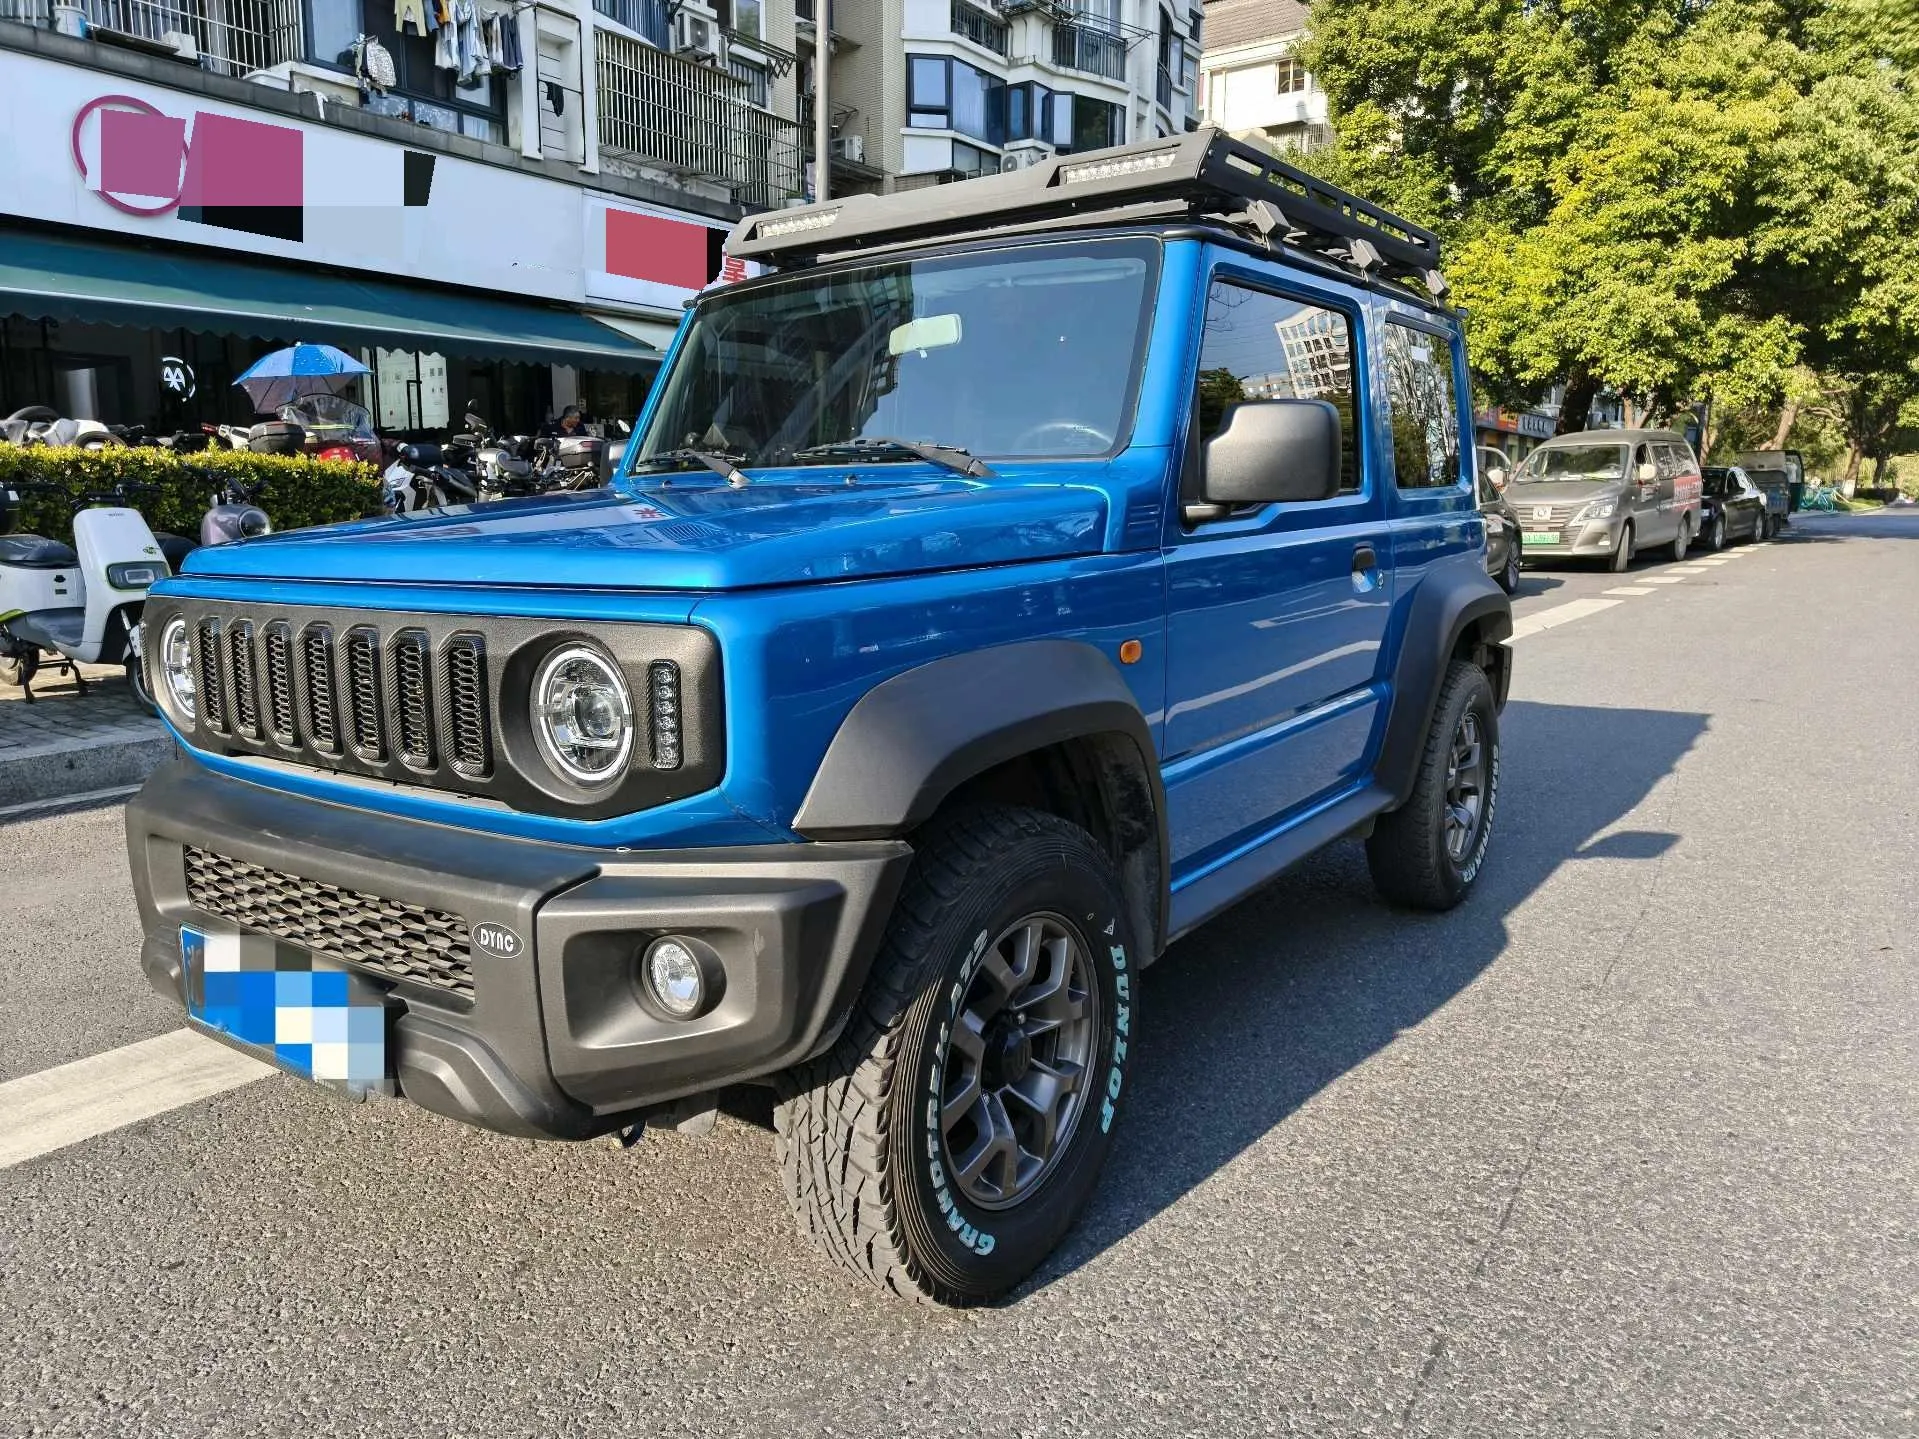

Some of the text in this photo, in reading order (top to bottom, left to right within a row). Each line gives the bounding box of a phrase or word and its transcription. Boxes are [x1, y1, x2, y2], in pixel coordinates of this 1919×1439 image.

[480, 927, 514, 952] DYNC
[1101, 944, 1130, 1134] DUNLOP
[927, 1021, 996, 1256] GRANDTREK
